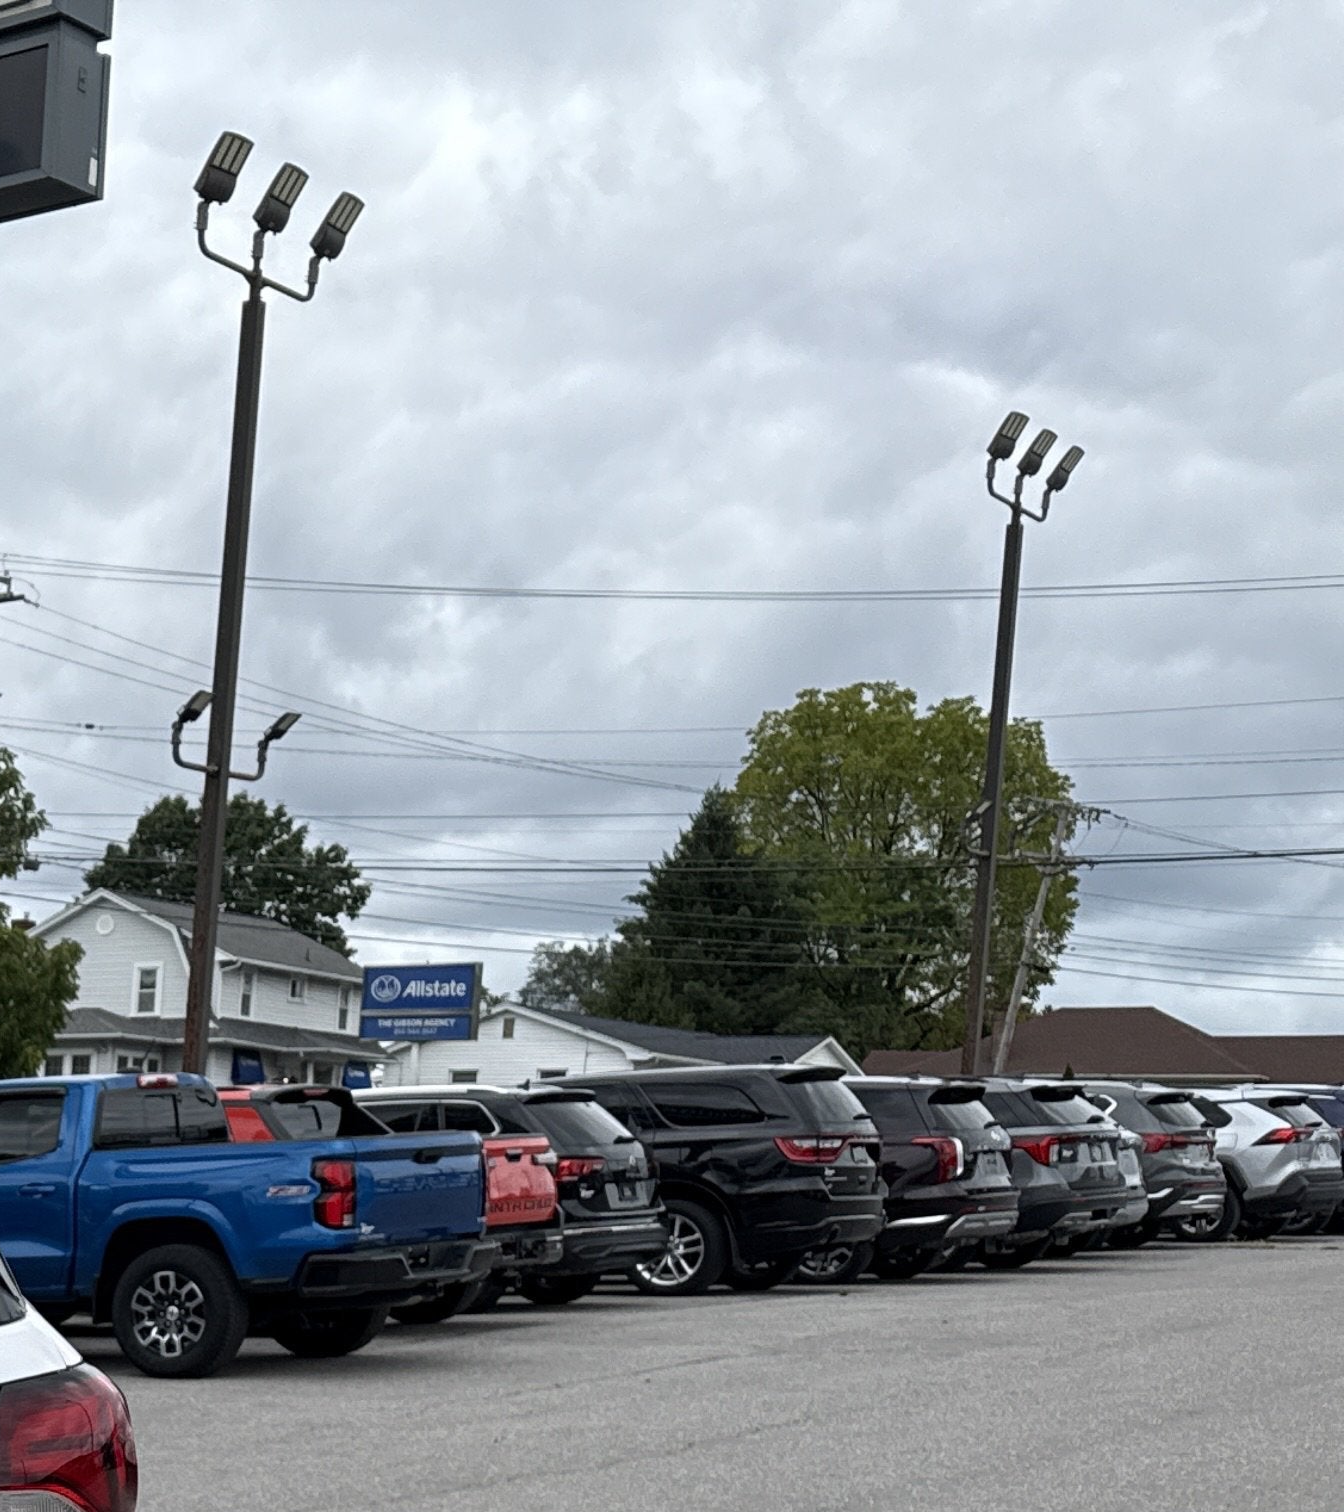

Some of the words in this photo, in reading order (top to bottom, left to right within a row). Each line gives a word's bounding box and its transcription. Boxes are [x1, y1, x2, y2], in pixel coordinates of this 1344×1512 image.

[402, 978, 466, 998] Allstate
[377, 1018, 392, 1028] THE
[424, 1017, 456, 1027] AGENCY
